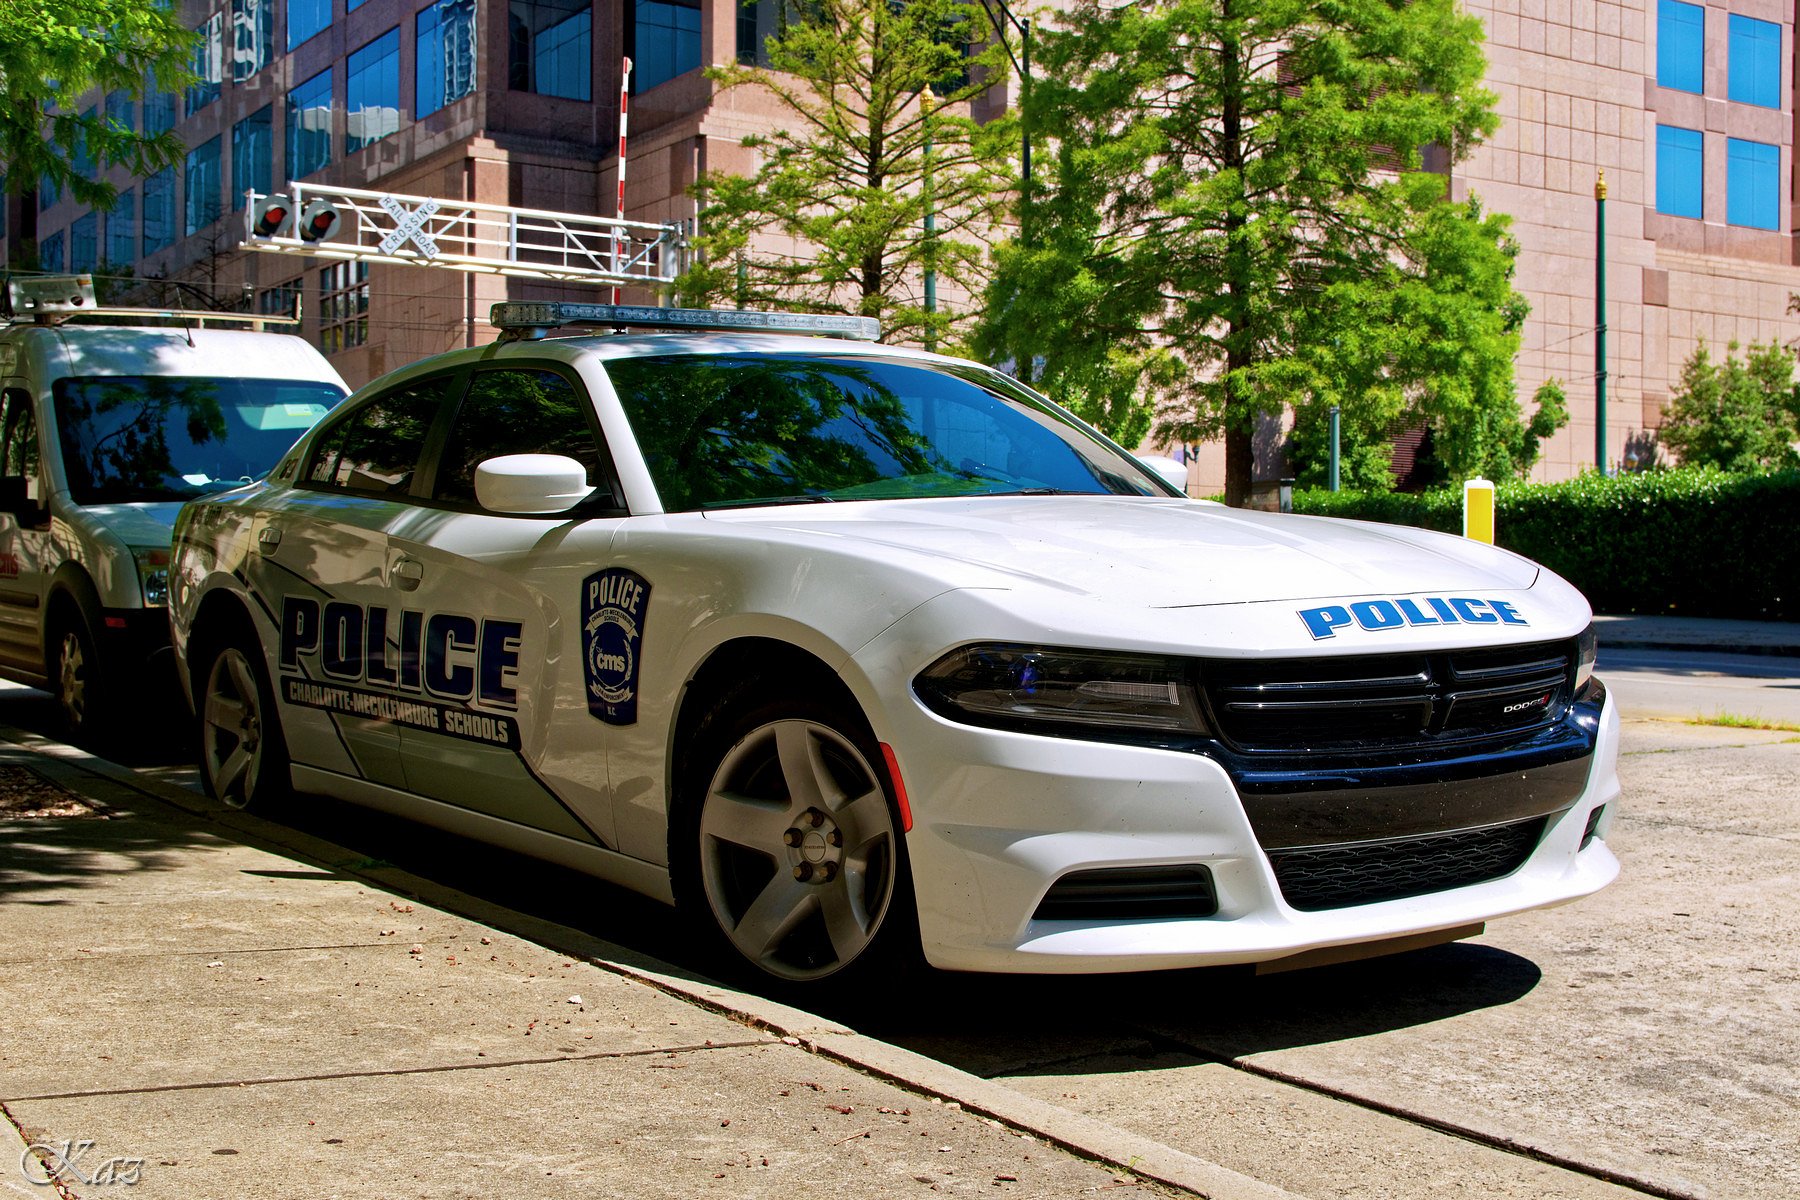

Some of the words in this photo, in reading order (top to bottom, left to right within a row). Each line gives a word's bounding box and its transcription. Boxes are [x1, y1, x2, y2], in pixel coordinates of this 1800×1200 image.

[383, 196, 404, 222] RAIL
[413, 230, 437, 256] ROAD
[385, 203, 435, 250] CROSSING
[589, 575, 643, 615] POLICE
[1296, 597, 1530, 641] POLICE
[279, 593, 526, 712] POLICE
[596, 653, 626, 673] cms
[289, 680, 440, 729] CHARLOTTE-MECKLENBURG
[445, 710, 509, 744] SCHOOLS
[1503, 697, 1545, 714] DODGE
